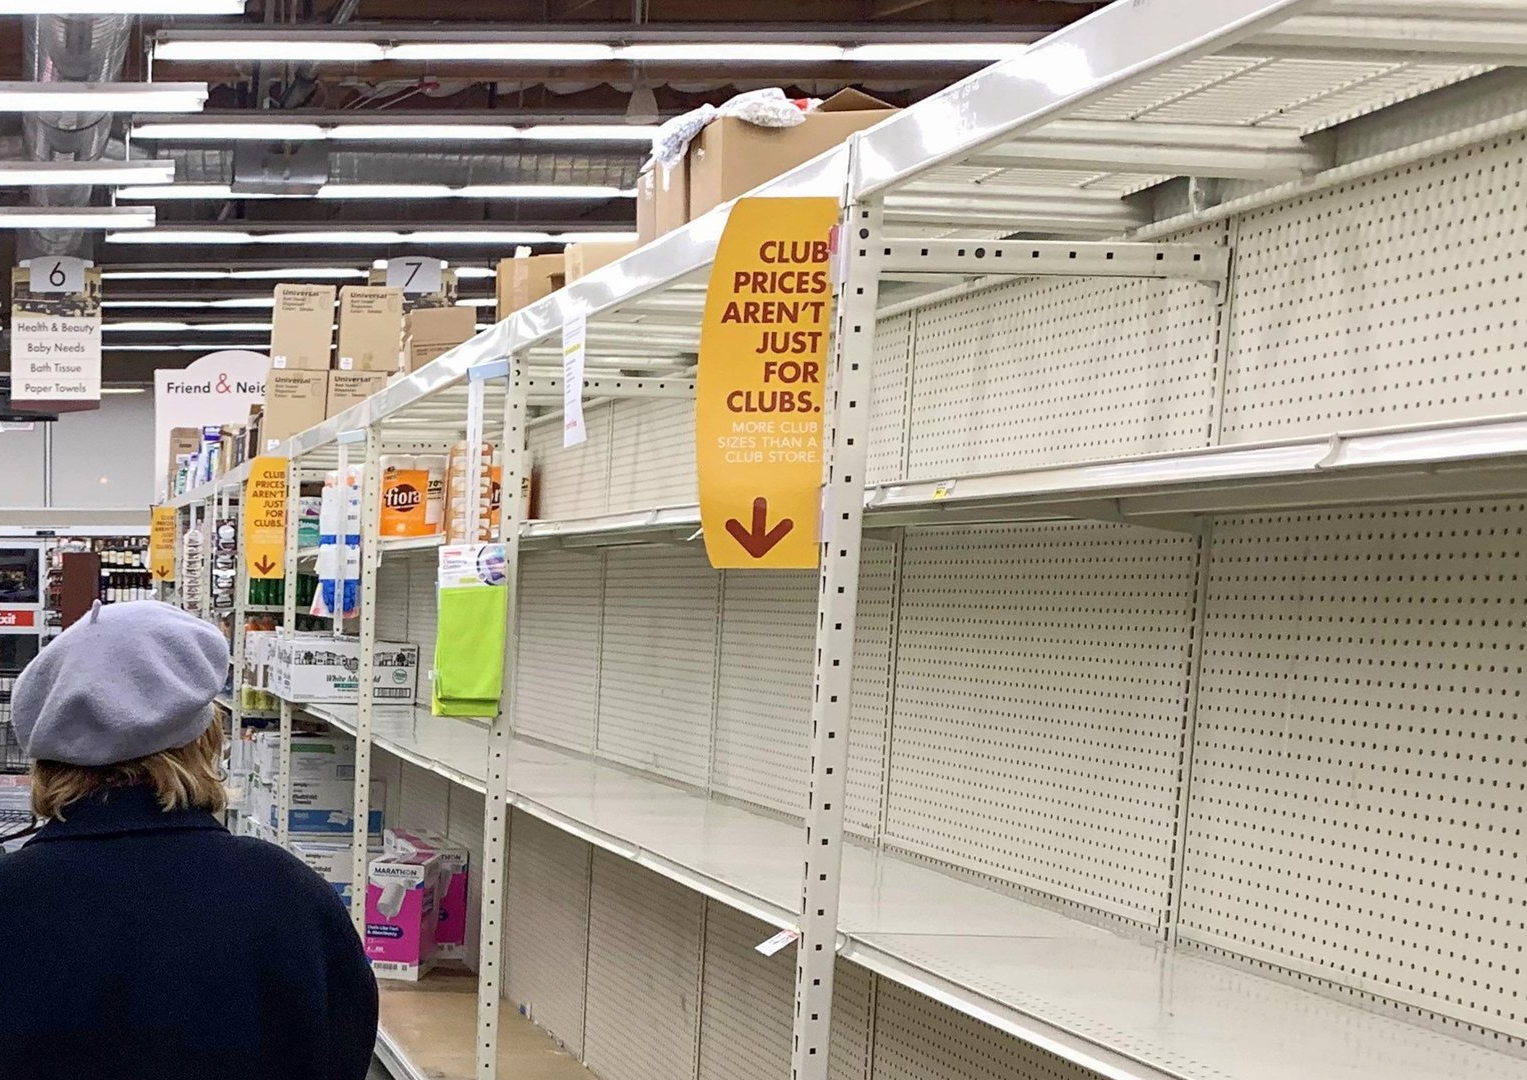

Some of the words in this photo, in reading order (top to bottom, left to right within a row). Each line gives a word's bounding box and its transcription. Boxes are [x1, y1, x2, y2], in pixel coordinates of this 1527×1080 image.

[759, 240, 829, 264] CLUB
[49, 262, 66, 287] 6
[405, 262, 422, 287] 7
[733, 271, 827, 294] PRICES
[282, 289, 319, 297] Universal
[721, 301, 825, 324] AREN'T
[17, 322, 48, 332] Health
[51, 323, 58, 332] &
[61, 323, 95, 334] Beauty
[27, 343, 51, 354] Baby
[54, 343, 85, 353] Needs
[755, 331, 822, 354] JUST
[30, 363, 52, 373] Bath
[54, 363, 82, 373] Tissue
[764, 361, 819, 384] FOR
[167, 381, 211, 394] Friend
[216, 373, 232, 394] &
[274, 376, 311, 384] Universal
[24, 383, 52, 395] Paper
[55, 382, 87, 393] Towels
[726, 390, 821, 414] CLUBS.
[732, 421, 776, 434] MORE
[780, 421, 818, 434] CLUB
[717, 436, 758, 448] SIZES
[762, 436, 803, 449] THAN
[806, 437, 818, 448] A
[725, 450, 763, 463] CLUB
[767, 450, 820, 463] STORE.
[263, 471, 285, 479] CLUB
[255, 480, 285, 489] PRICES
[384, 487, 421, 507] fiora
[263, 500, 284, 508] JUST
[254, 519, 284, 528] CLUBS.
[374, 867, 417, 876] MARATHON
